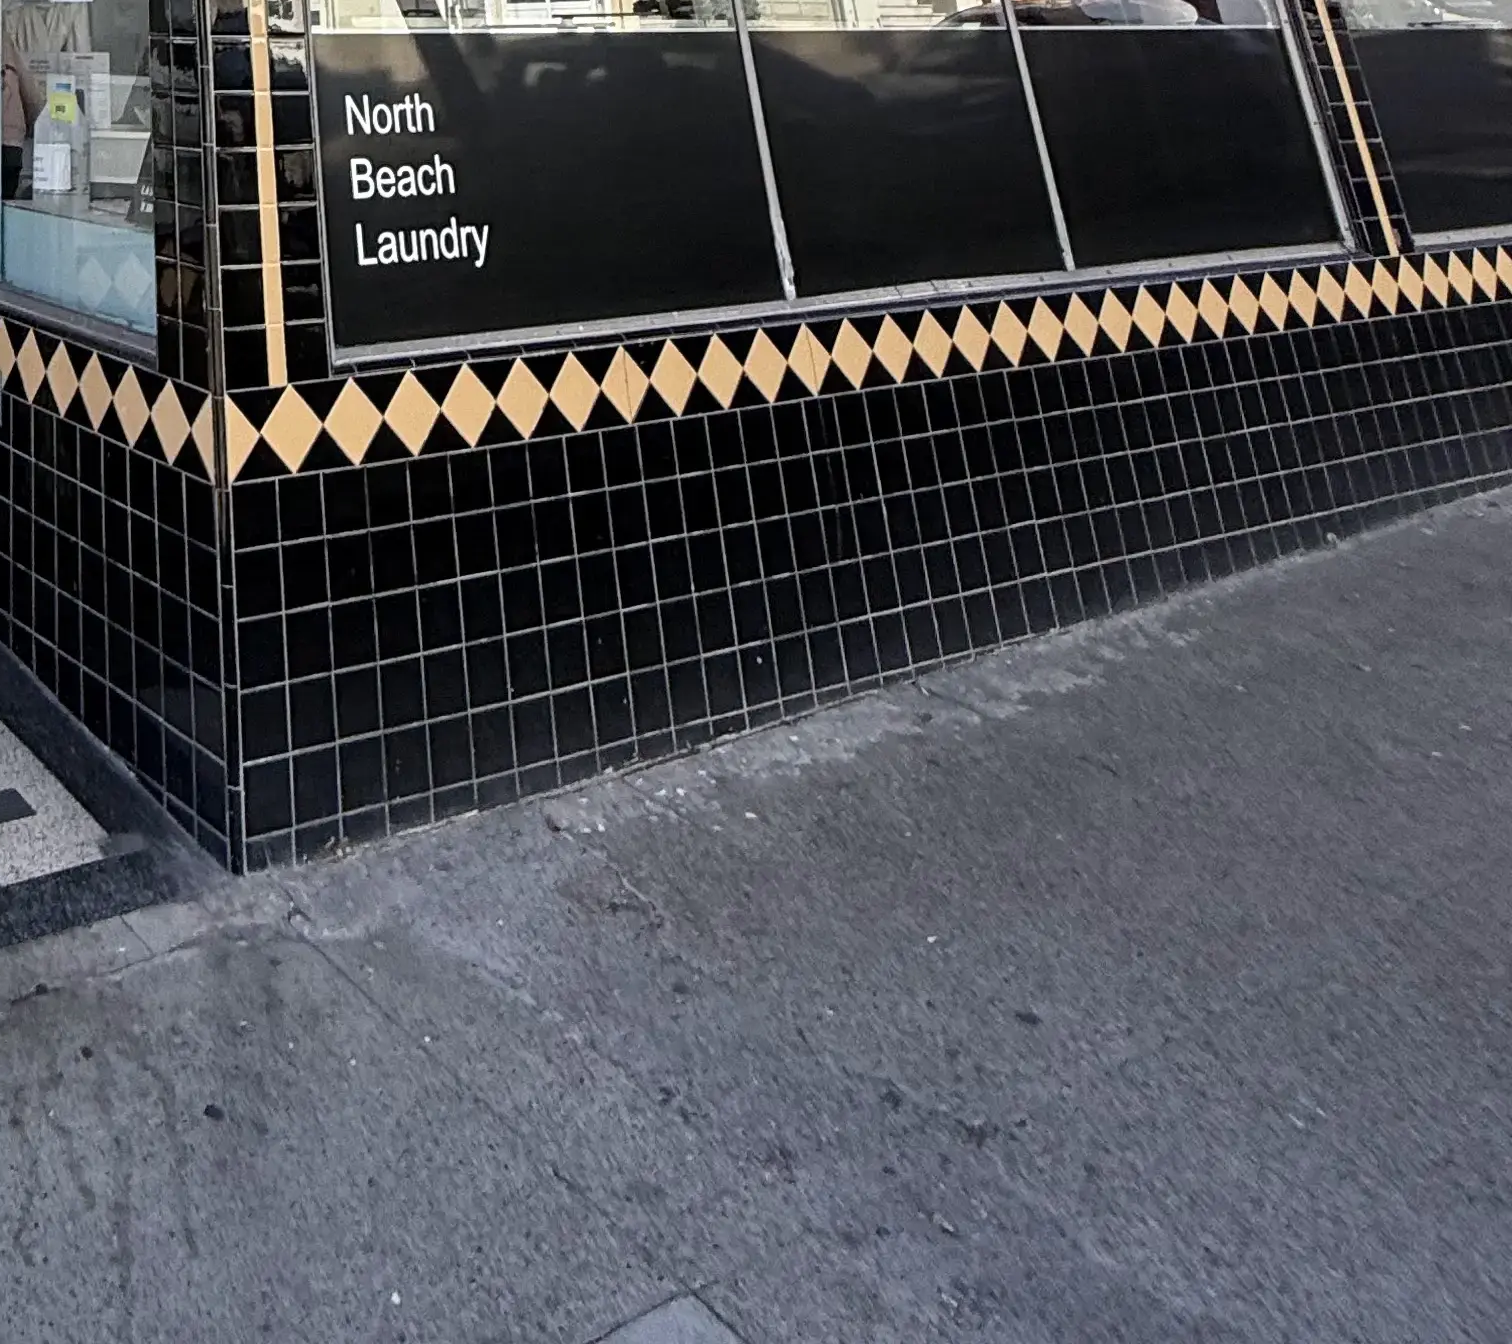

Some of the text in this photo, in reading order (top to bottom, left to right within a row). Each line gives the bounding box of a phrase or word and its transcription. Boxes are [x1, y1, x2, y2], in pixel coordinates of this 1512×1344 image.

[344, 92, 436, 136] North
[349, 153, 456, 200] Beach
[354, 215, 489, 269] Laundry
